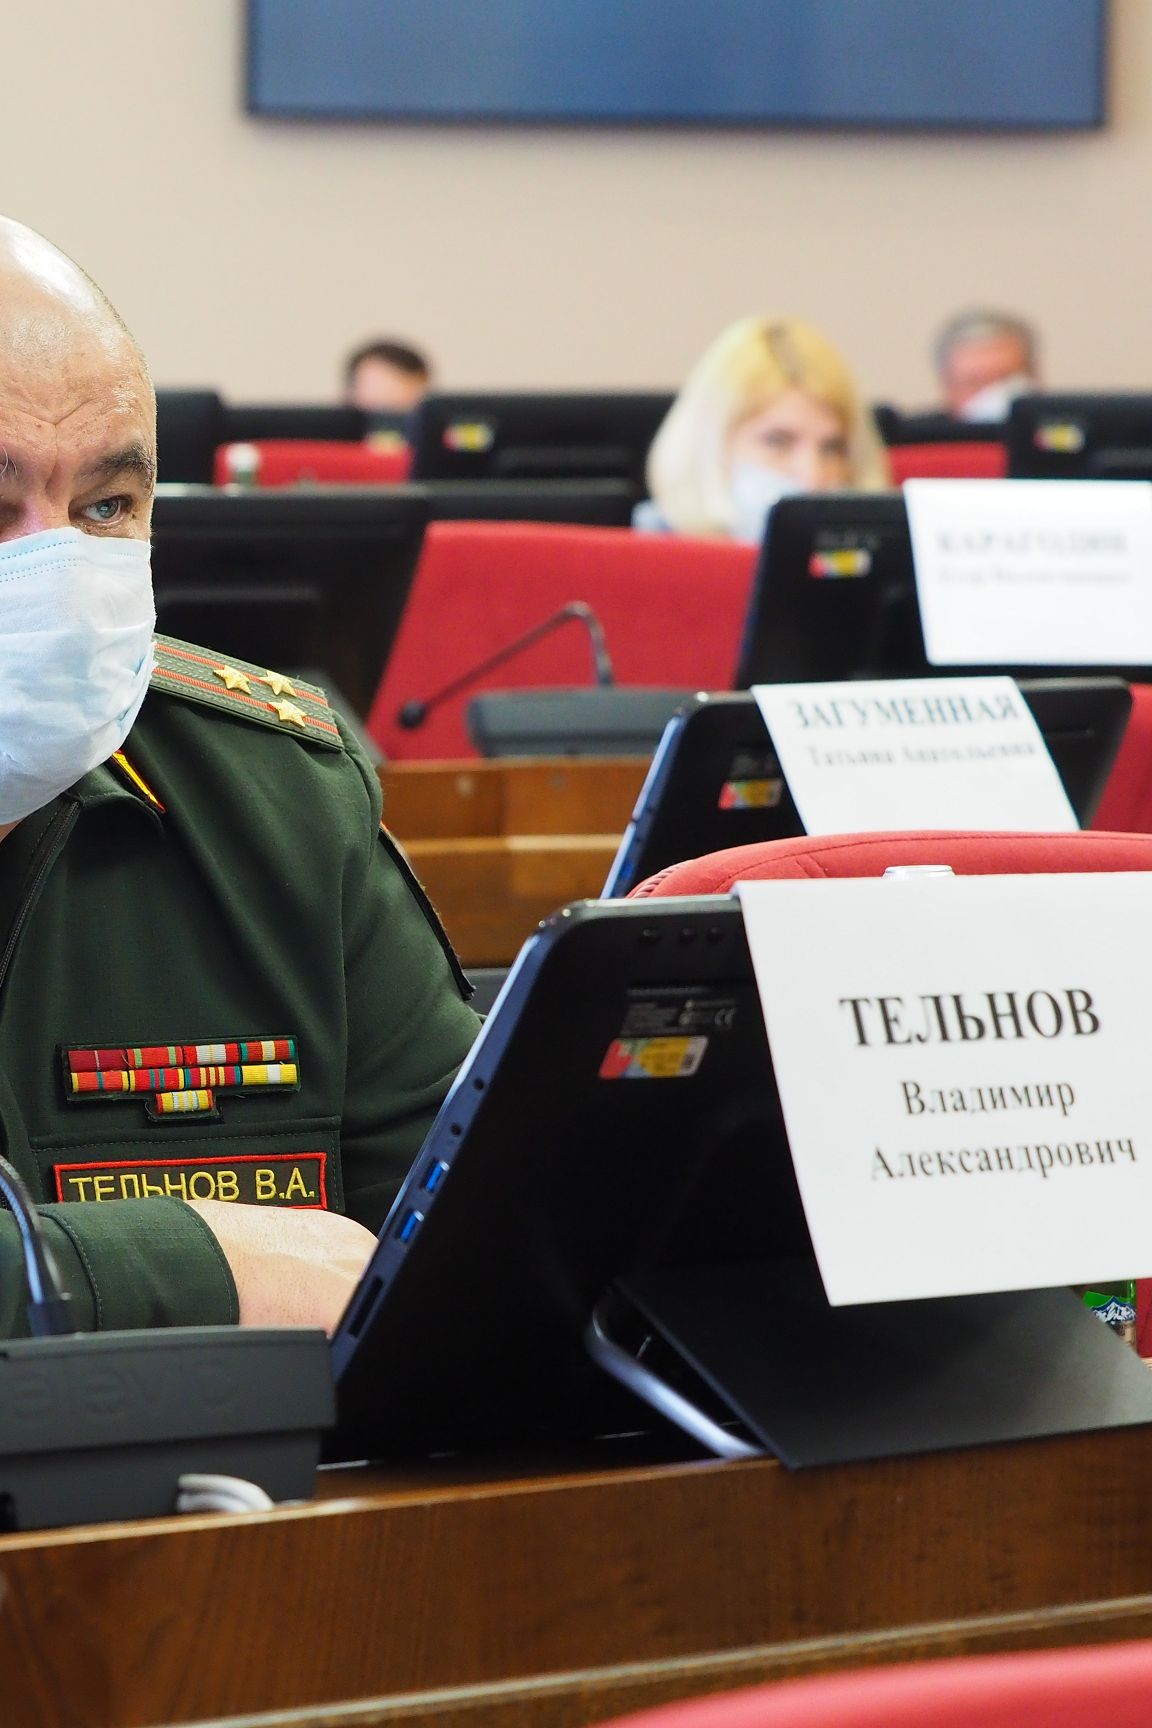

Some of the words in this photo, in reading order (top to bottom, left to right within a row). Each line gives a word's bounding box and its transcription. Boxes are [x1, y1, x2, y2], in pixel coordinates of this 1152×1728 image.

[789, 694, 1021, 730] ЗАГУМЕННАЯ
[839, 988, 1101, 1047] ТЕЛЬНОВ
[900, 1080, 1076, 1117] Владимир
[870, 1136, 1138, 1180] Александрович
[68, 1169, 240, 1201] ТЕЛЬНОВ
